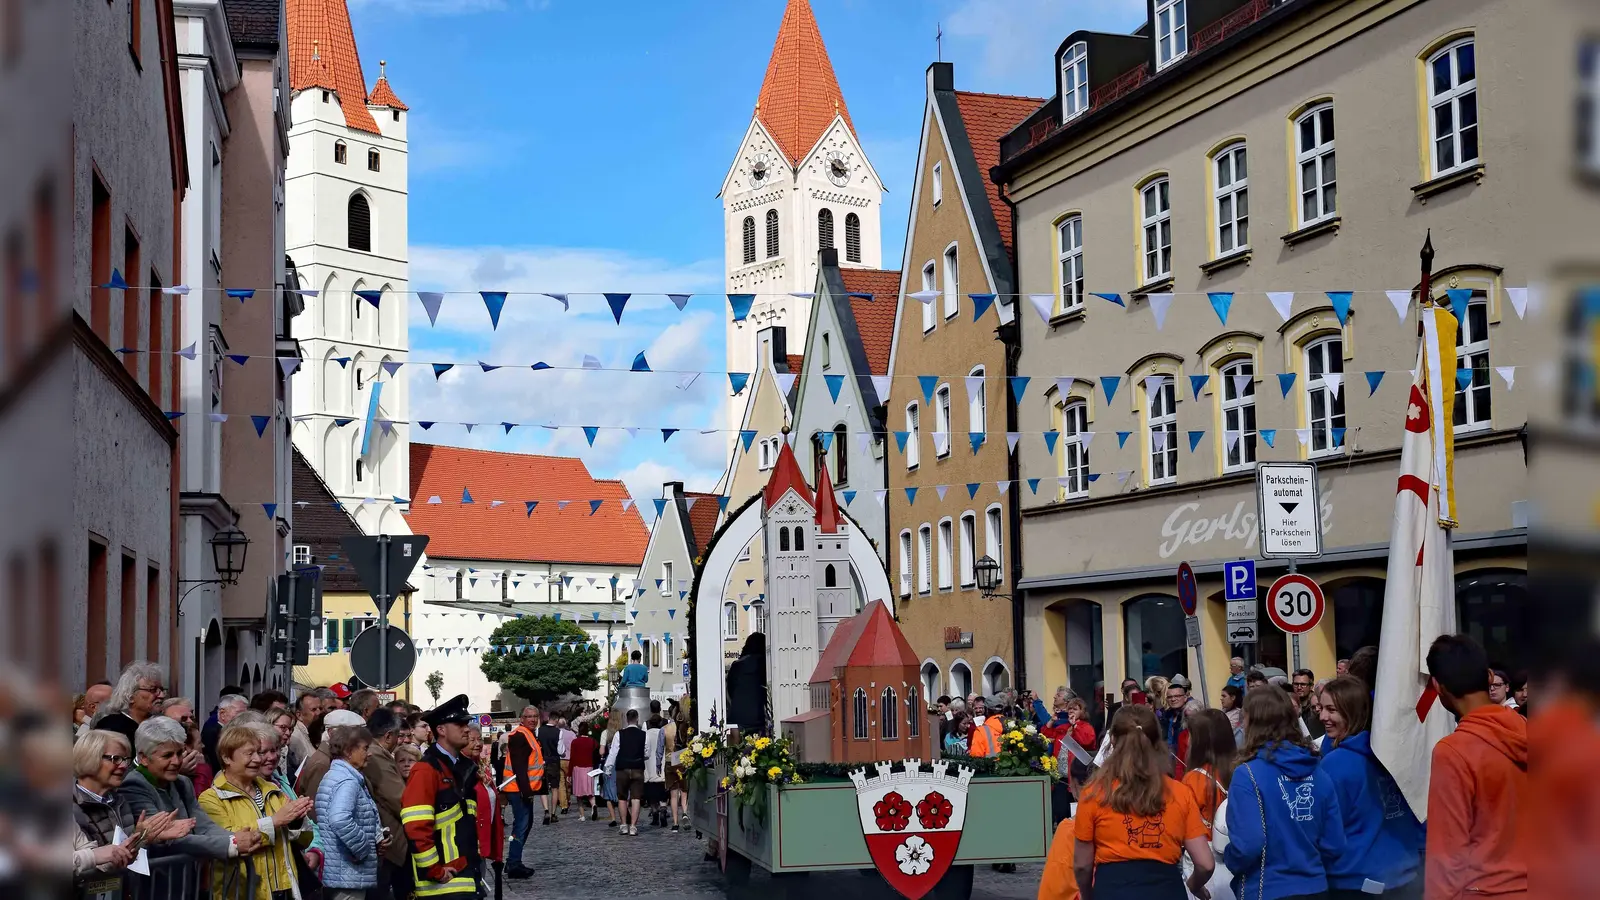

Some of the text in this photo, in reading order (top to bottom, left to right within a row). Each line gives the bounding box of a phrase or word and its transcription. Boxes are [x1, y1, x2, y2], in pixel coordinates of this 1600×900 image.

[1266, 474, 1309, 485] Parkschein-
[1273, 488, 1303, 497] automat
[1231, 566, 1248, 595] P
[1279, 591, 1312, 617] 30
